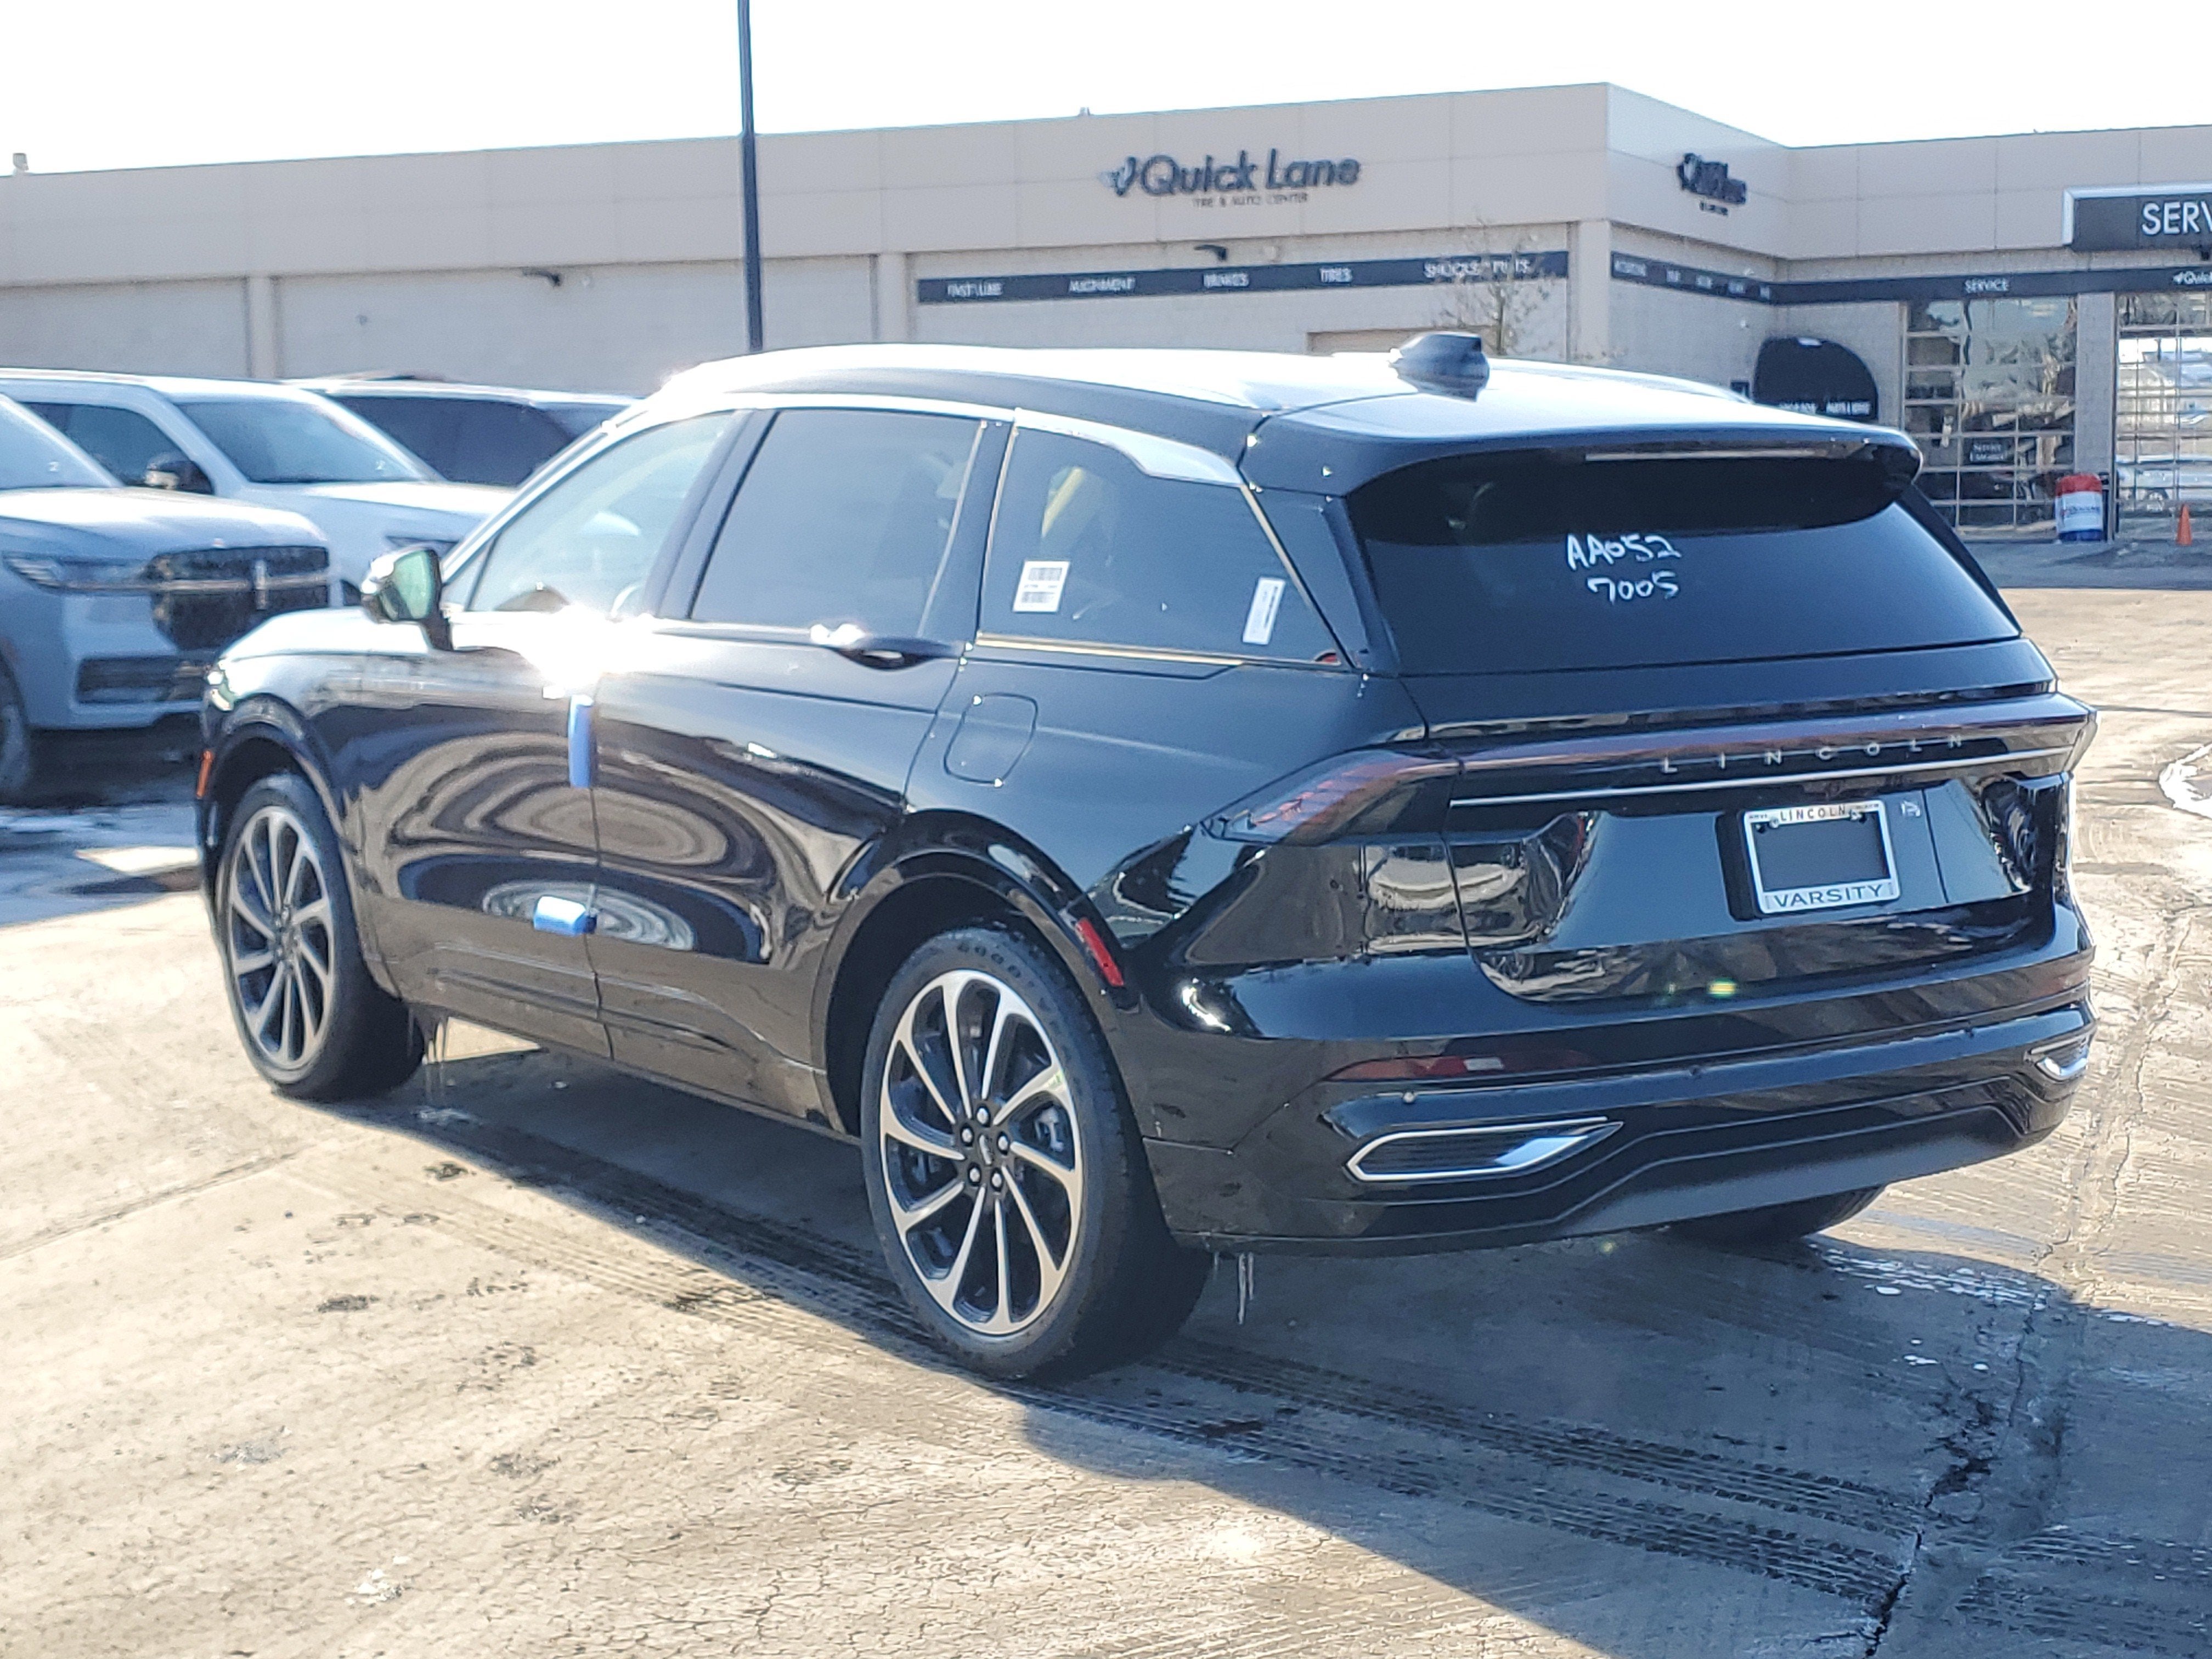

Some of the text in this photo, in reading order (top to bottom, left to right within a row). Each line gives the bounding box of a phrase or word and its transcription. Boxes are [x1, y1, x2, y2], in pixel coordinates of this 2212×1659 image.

[1141, 148, 1360, 196] Quick Lane
[1587, 569, 1679, 605] 7005
[1663, 733, 1963, 774] LINCOLN
[1779, 805, 1847, 822] LINCOLN
[1773, 883, 1883, 908] VARSITY
